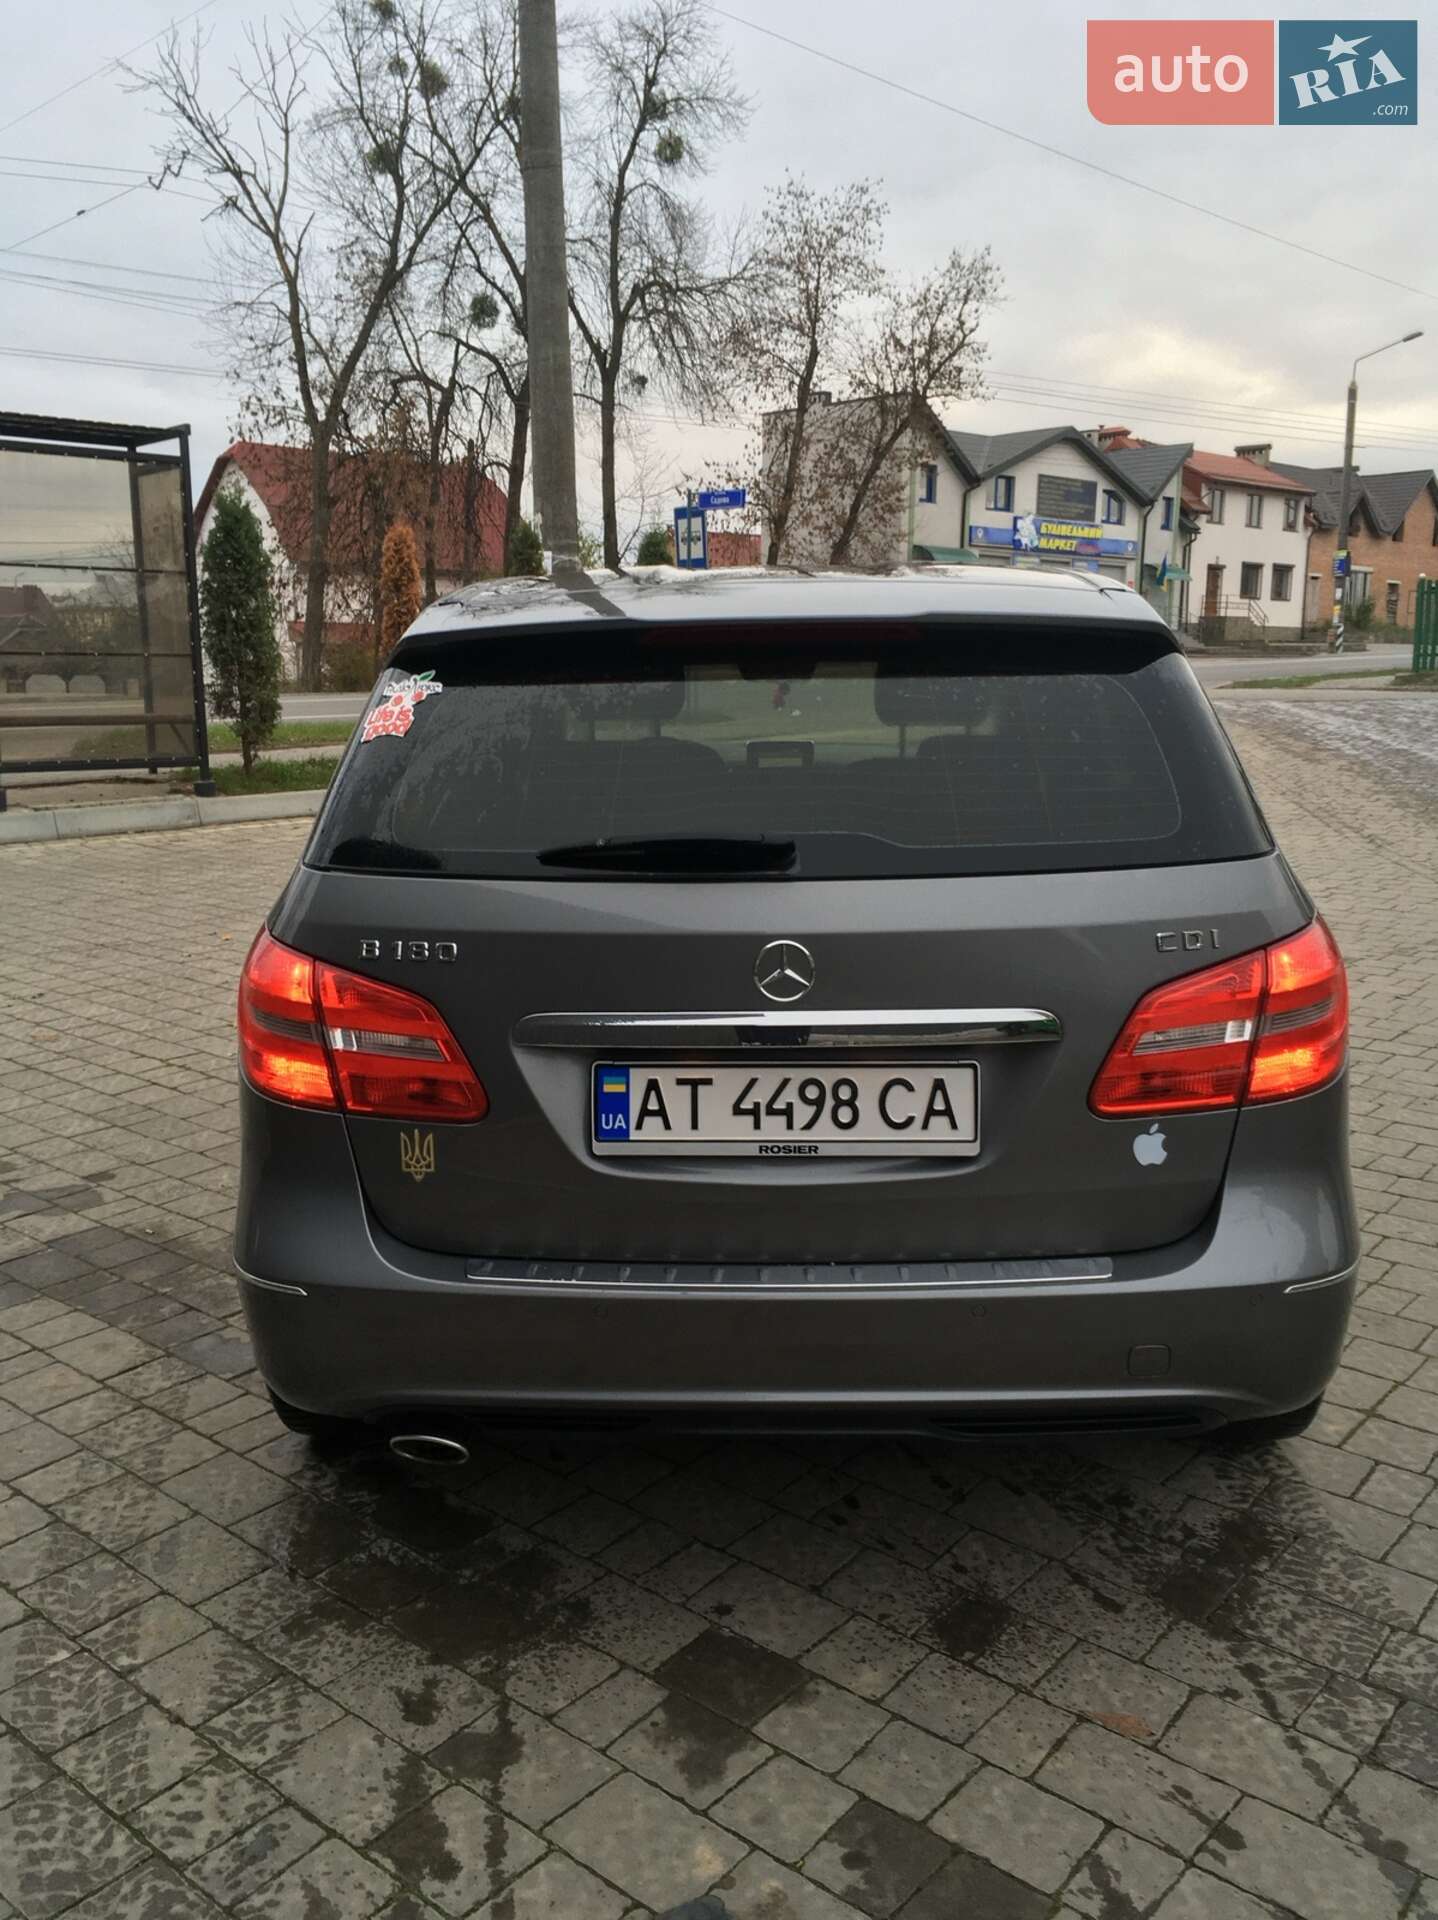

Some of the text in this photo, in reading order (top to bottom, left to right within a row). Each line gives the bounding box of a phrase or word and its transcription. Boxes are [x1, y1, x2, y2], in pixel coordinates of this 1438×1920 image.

[1039, 537, 1078, 552] МАРКЕТ
[1156, 928, 1221, 952] CDI
[359, 939, 459, 962] B 180
[634, 1077, 959, 1131] AT 4498 CA
[602, 1113, 627, 1130] UA
[758, 1144, 819, 1155] ROSIER
